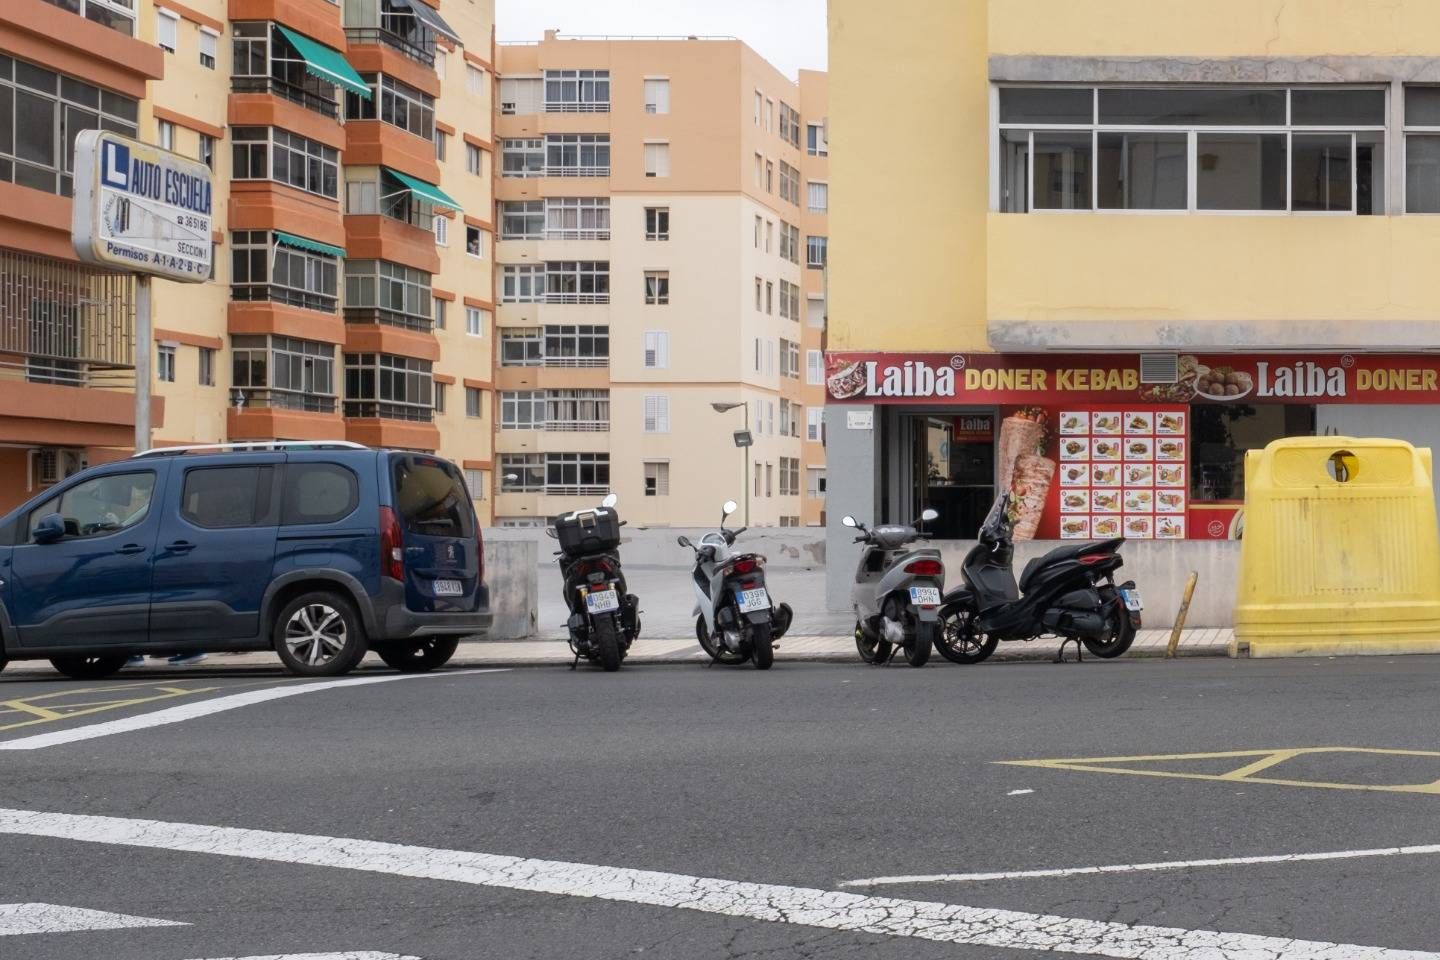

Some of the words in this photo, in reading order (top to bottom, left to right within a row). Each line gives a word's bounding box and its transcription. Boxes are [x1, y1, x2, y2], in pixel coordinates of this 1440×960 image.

[132, 158, 160, 200] AUTO
[165, 168, 212, 216] ESCUELA
[107, 241, 149, 262] Permisos
[865, 360, 955, 397] Laiba
[965, 368, 1048, 391] DONER
[1055, 368, 1139, 391] KEBAB
[1256, 361, 1347, 397] Laiba
[1356, 368, 1438, 391] DONER
[960, 417, 990, 431] Laiba
